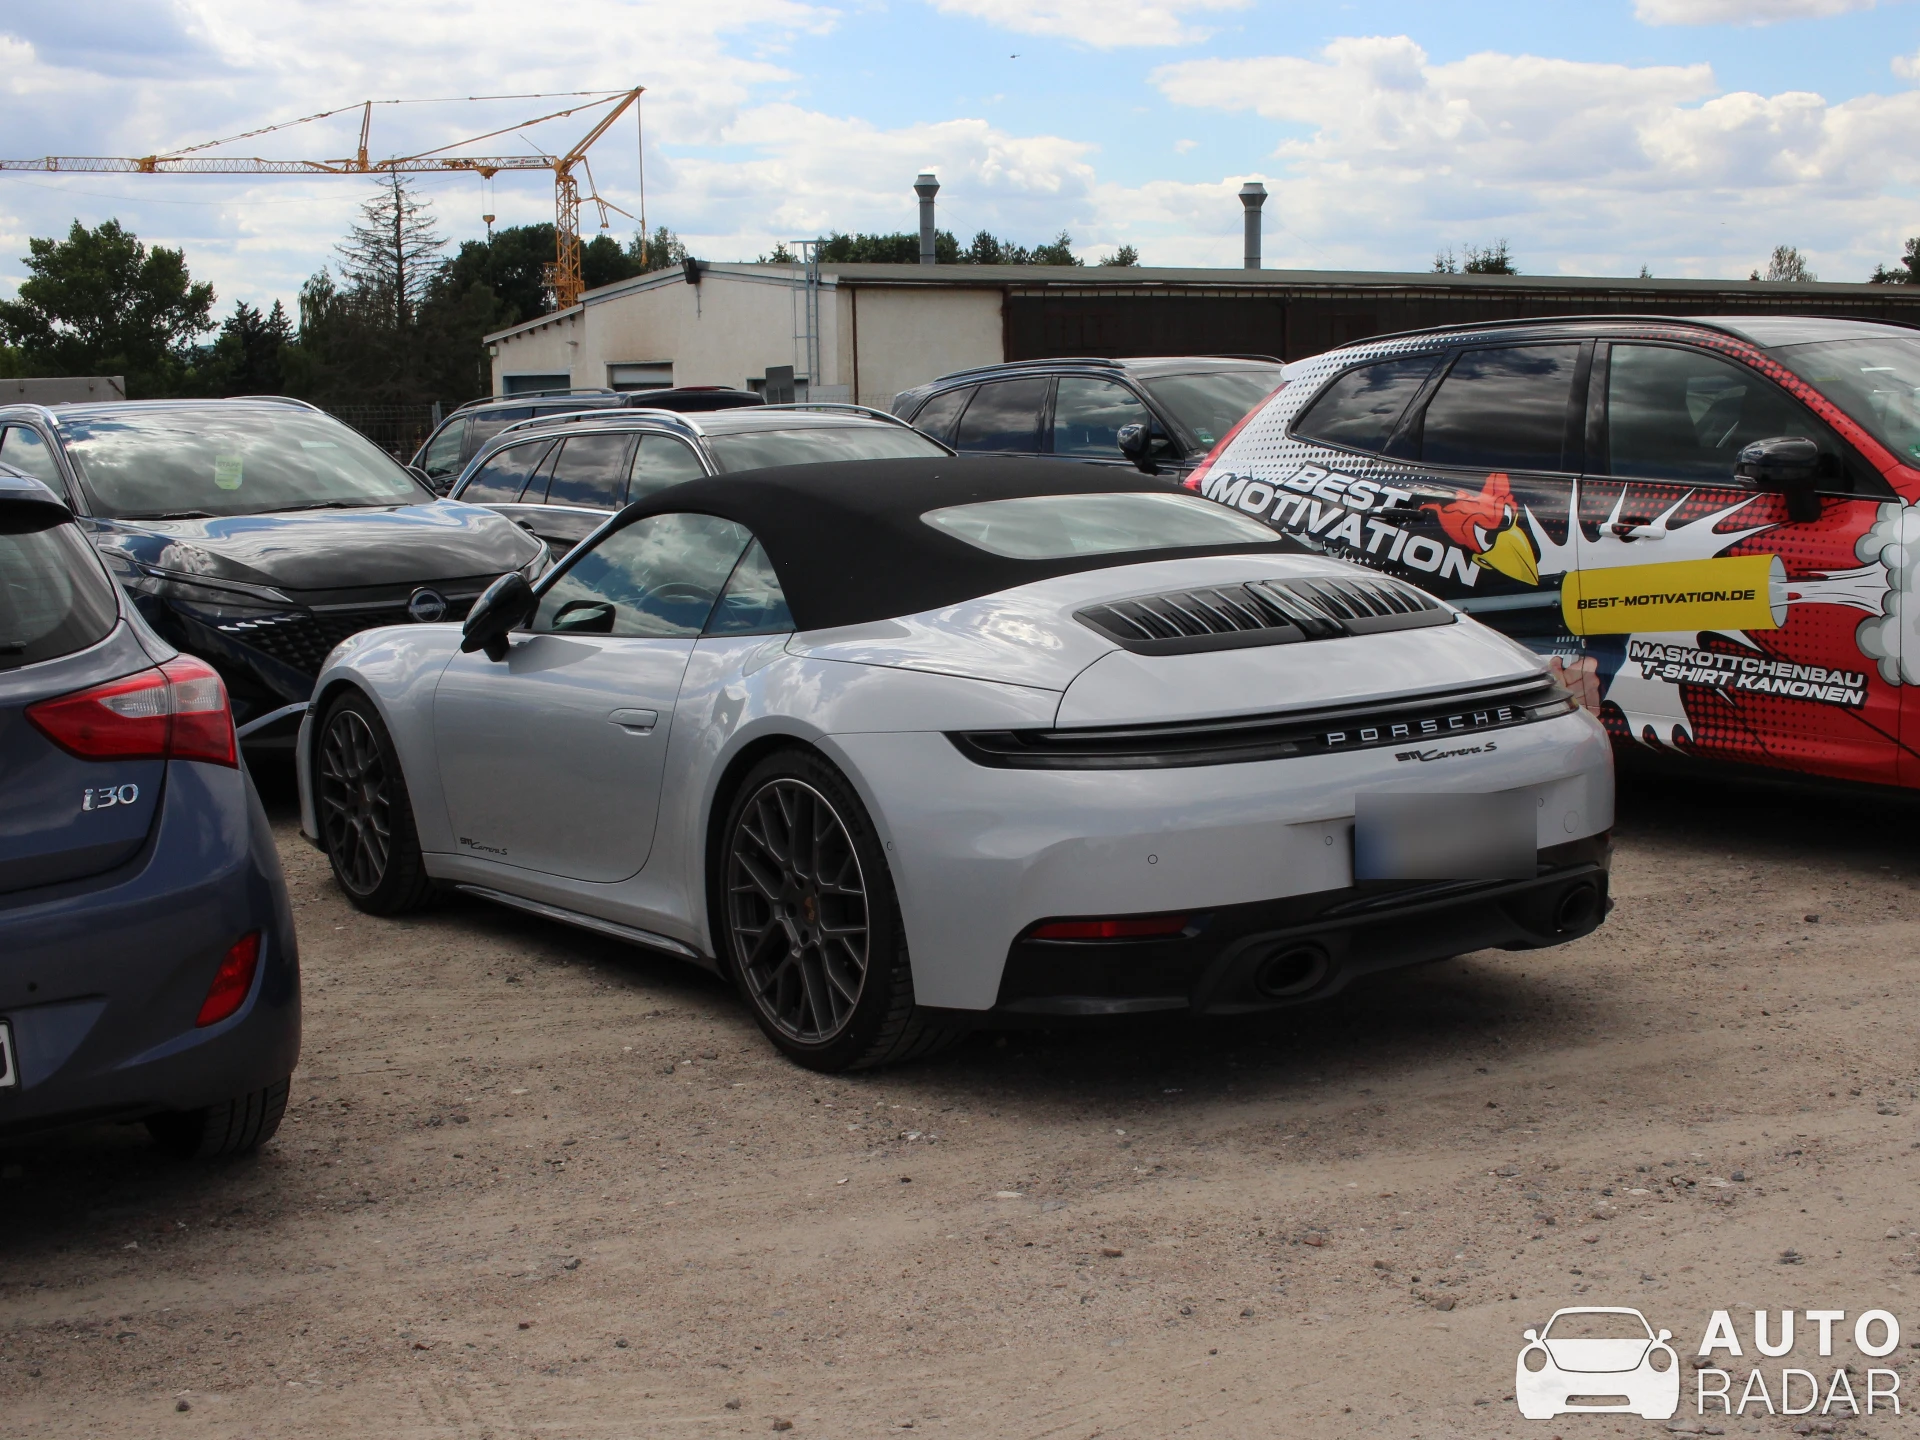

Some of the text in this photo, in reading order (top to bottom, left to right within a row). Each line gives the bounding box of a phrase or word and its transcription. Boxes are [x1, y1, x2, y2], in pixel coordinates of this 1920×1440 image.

[1283, 464, 1412, 513] BEST
[1206, 474, 1482, 587] MOTIVATION
[1577, 590, 1755, 609] BEST-MOTIVATION.DE
[1630, 642, 1864, 688] MASKOTTCHENBAU
[1643, 661, 1864, 705] T-SHIRT KANONEN
[1327, 708, 1512, 745] PORSCHE
[1484, 741, 1498, 752] S
[82, 783, 139, 811] i30
